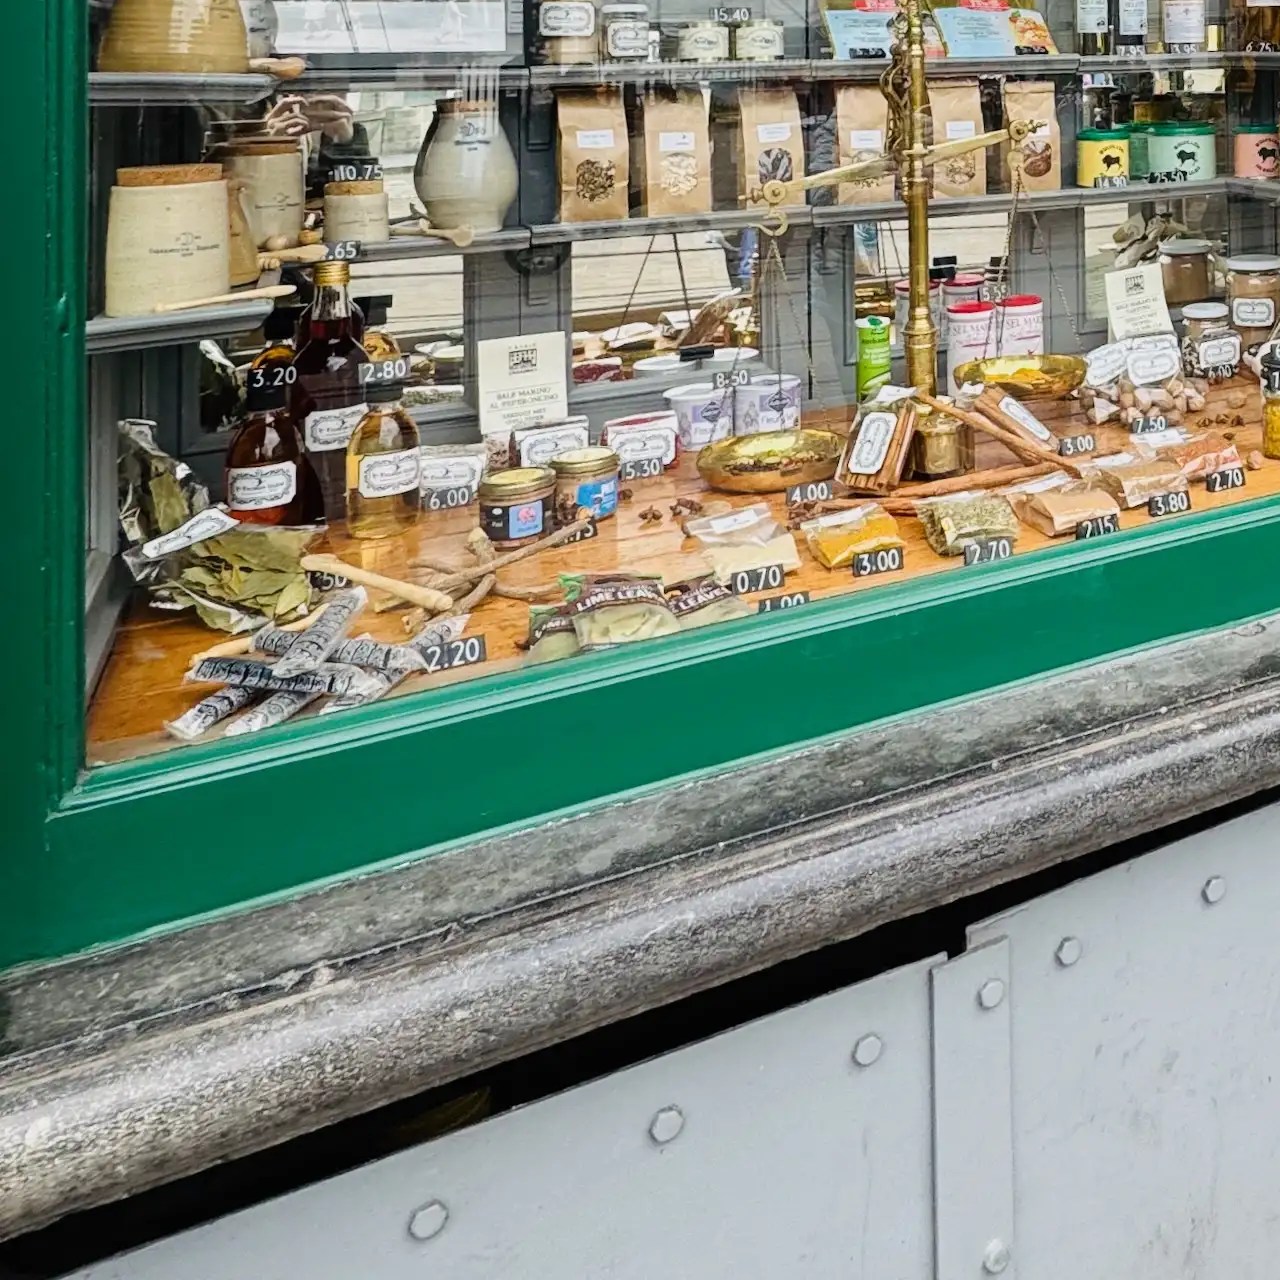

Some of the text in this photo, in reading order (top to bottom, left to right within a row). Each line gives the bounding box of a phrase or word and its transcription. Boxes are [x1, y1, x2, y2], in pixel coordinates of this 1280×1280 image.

[328, 241, 358, 260] .65
[252, 365, 297, 389] 3.20
[364, 358, 407, 383] 2.80
[1063, 435, 1094, 454] 3.00
[624, 459, 661, 480] 5.30
[1210, 469, 1243, 492] 2.70
[429, 486, 469, 510] 6.00
[1154, 492, 1189, 515] 3.80
[858, 549, 900, 576] 3.00
[735, 565, 782, 593] 0.70
[576, 591, 616, 612] LIME
[425, 639, 482, 673] 2.20
